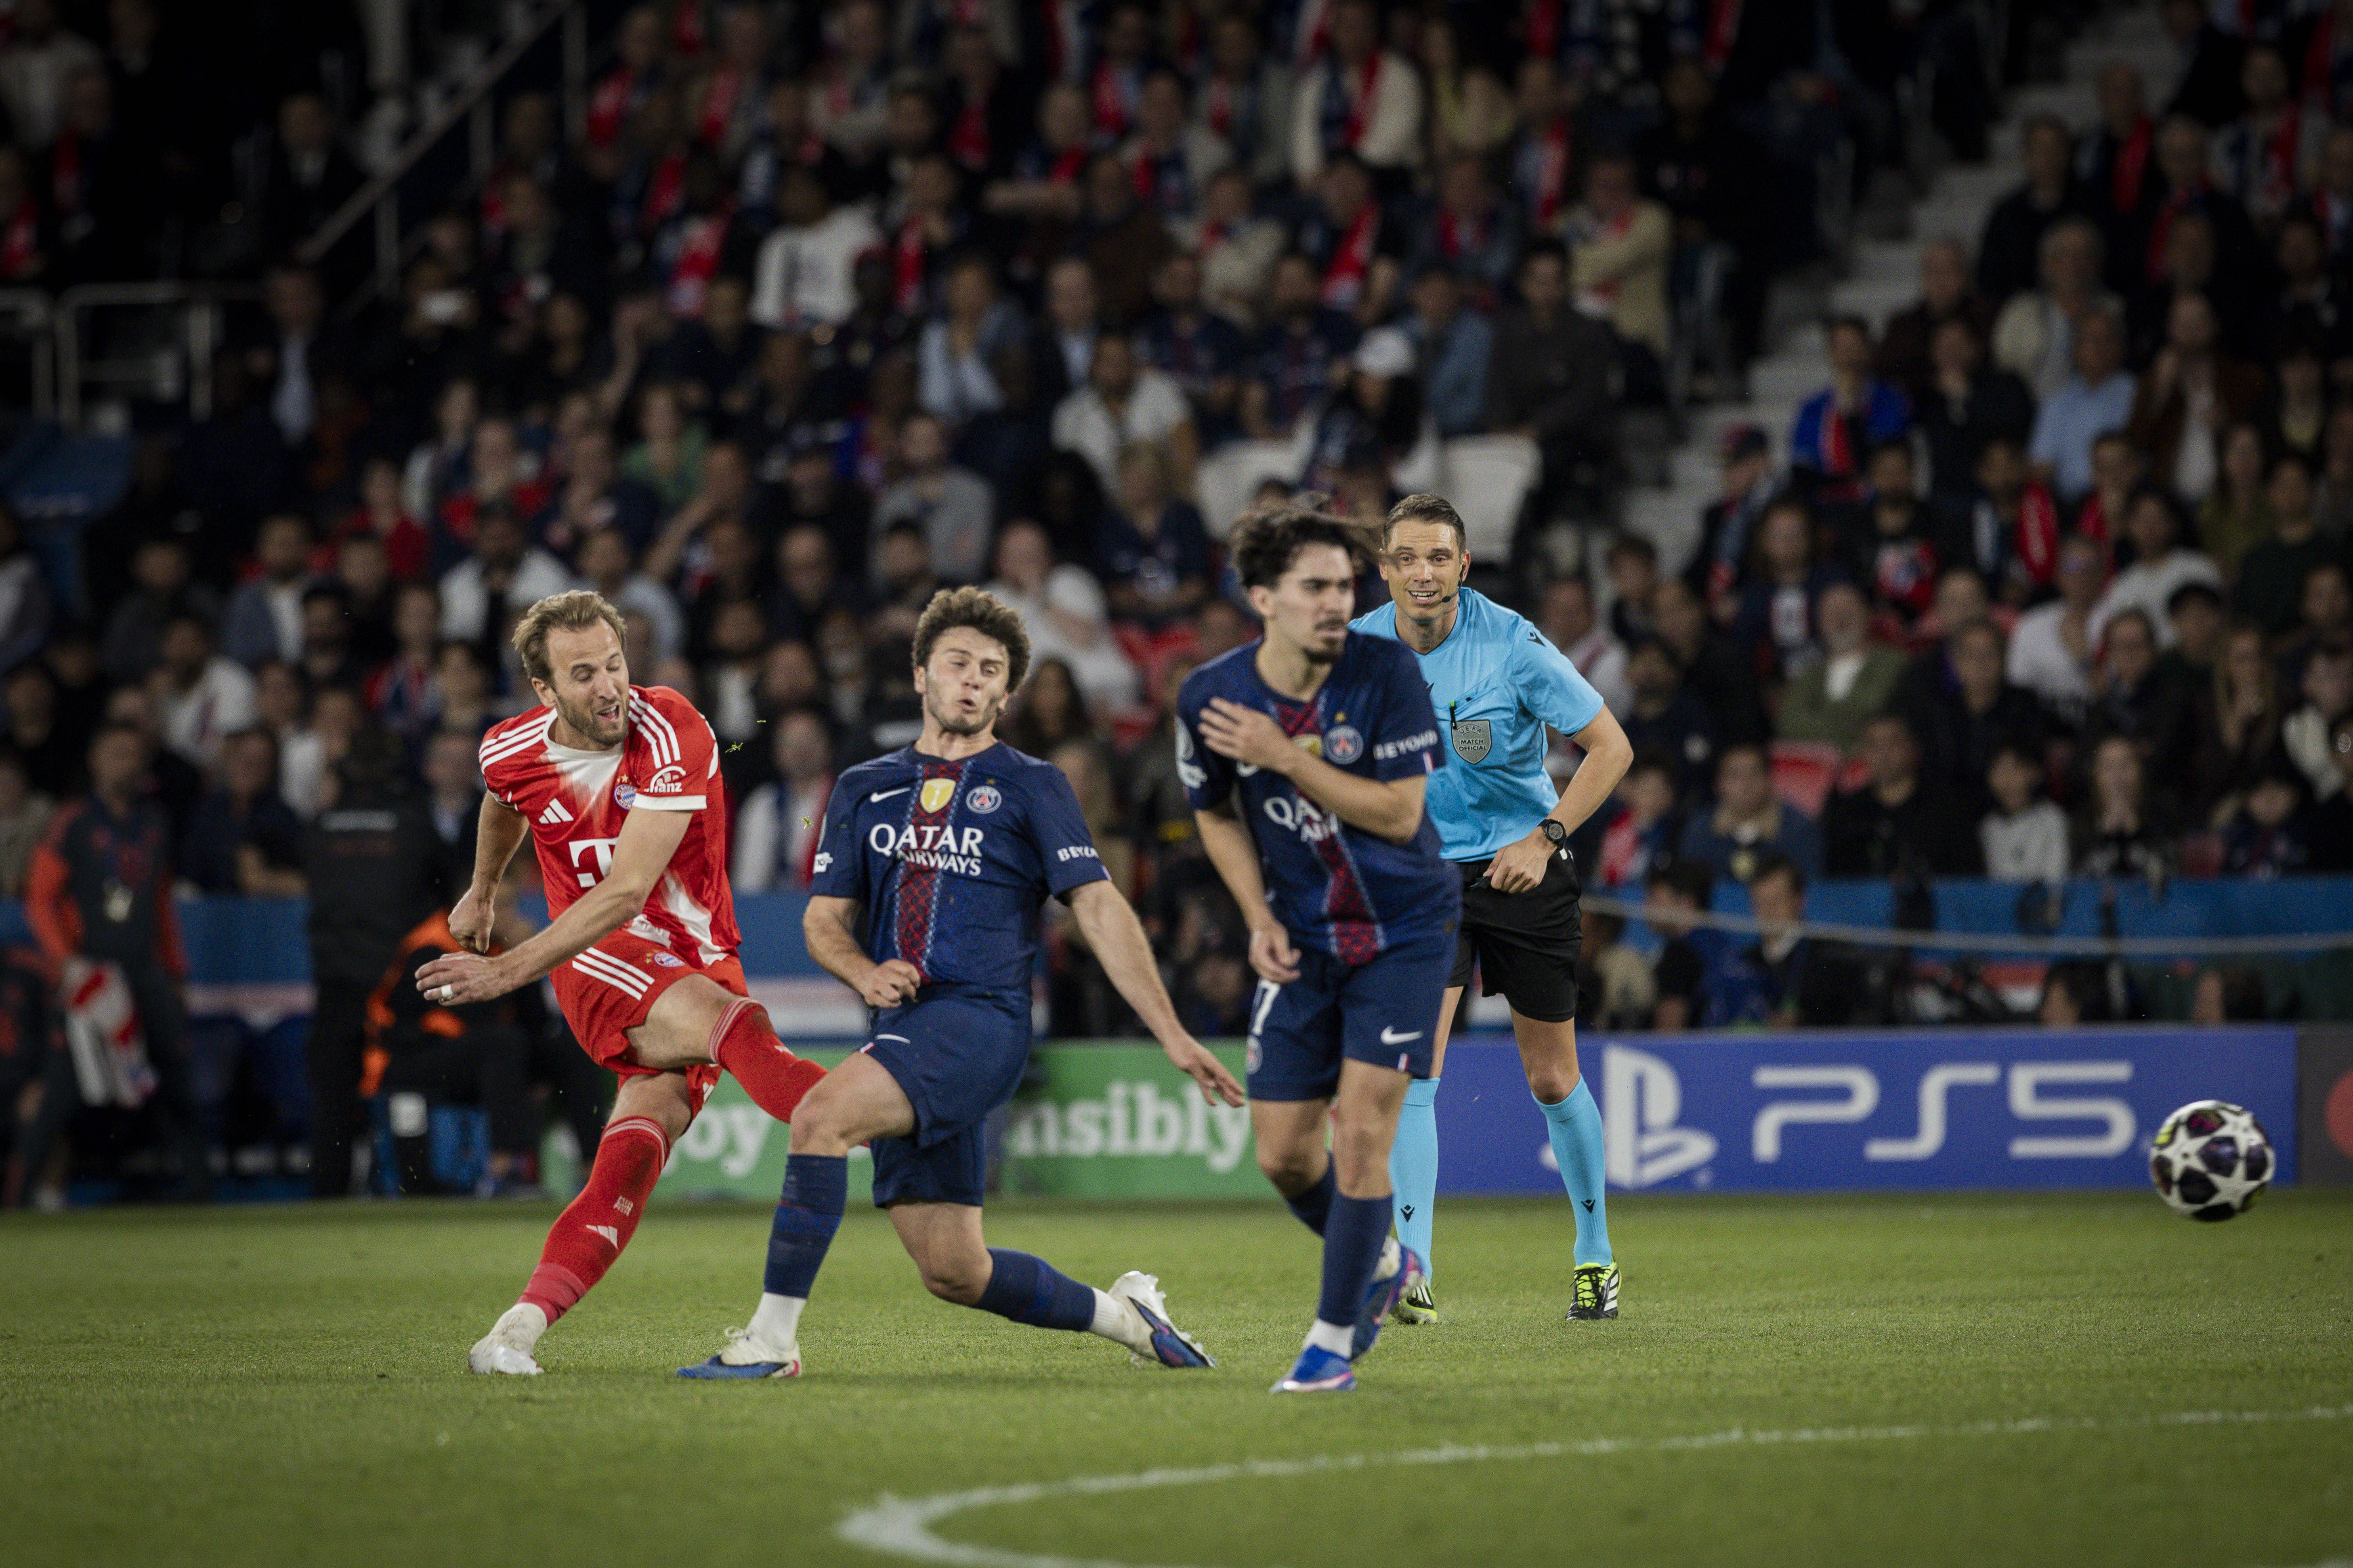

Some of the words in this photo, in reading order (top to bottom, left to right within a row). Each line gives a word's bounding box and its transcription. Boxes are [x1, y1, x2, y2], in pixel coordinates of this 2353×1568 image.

[1459, 726, 1482, 734] UEFA
[569, 837, 619, 888] T
[869, 823, 984, 857] QATAR
[895, 849, 982, 876] AIRWAYS
[1008, 1081, 1253, 1173] nsibly
[1752, 1061, 2137, 1162] PS5
[661, 1105, 774, 1178] oy
